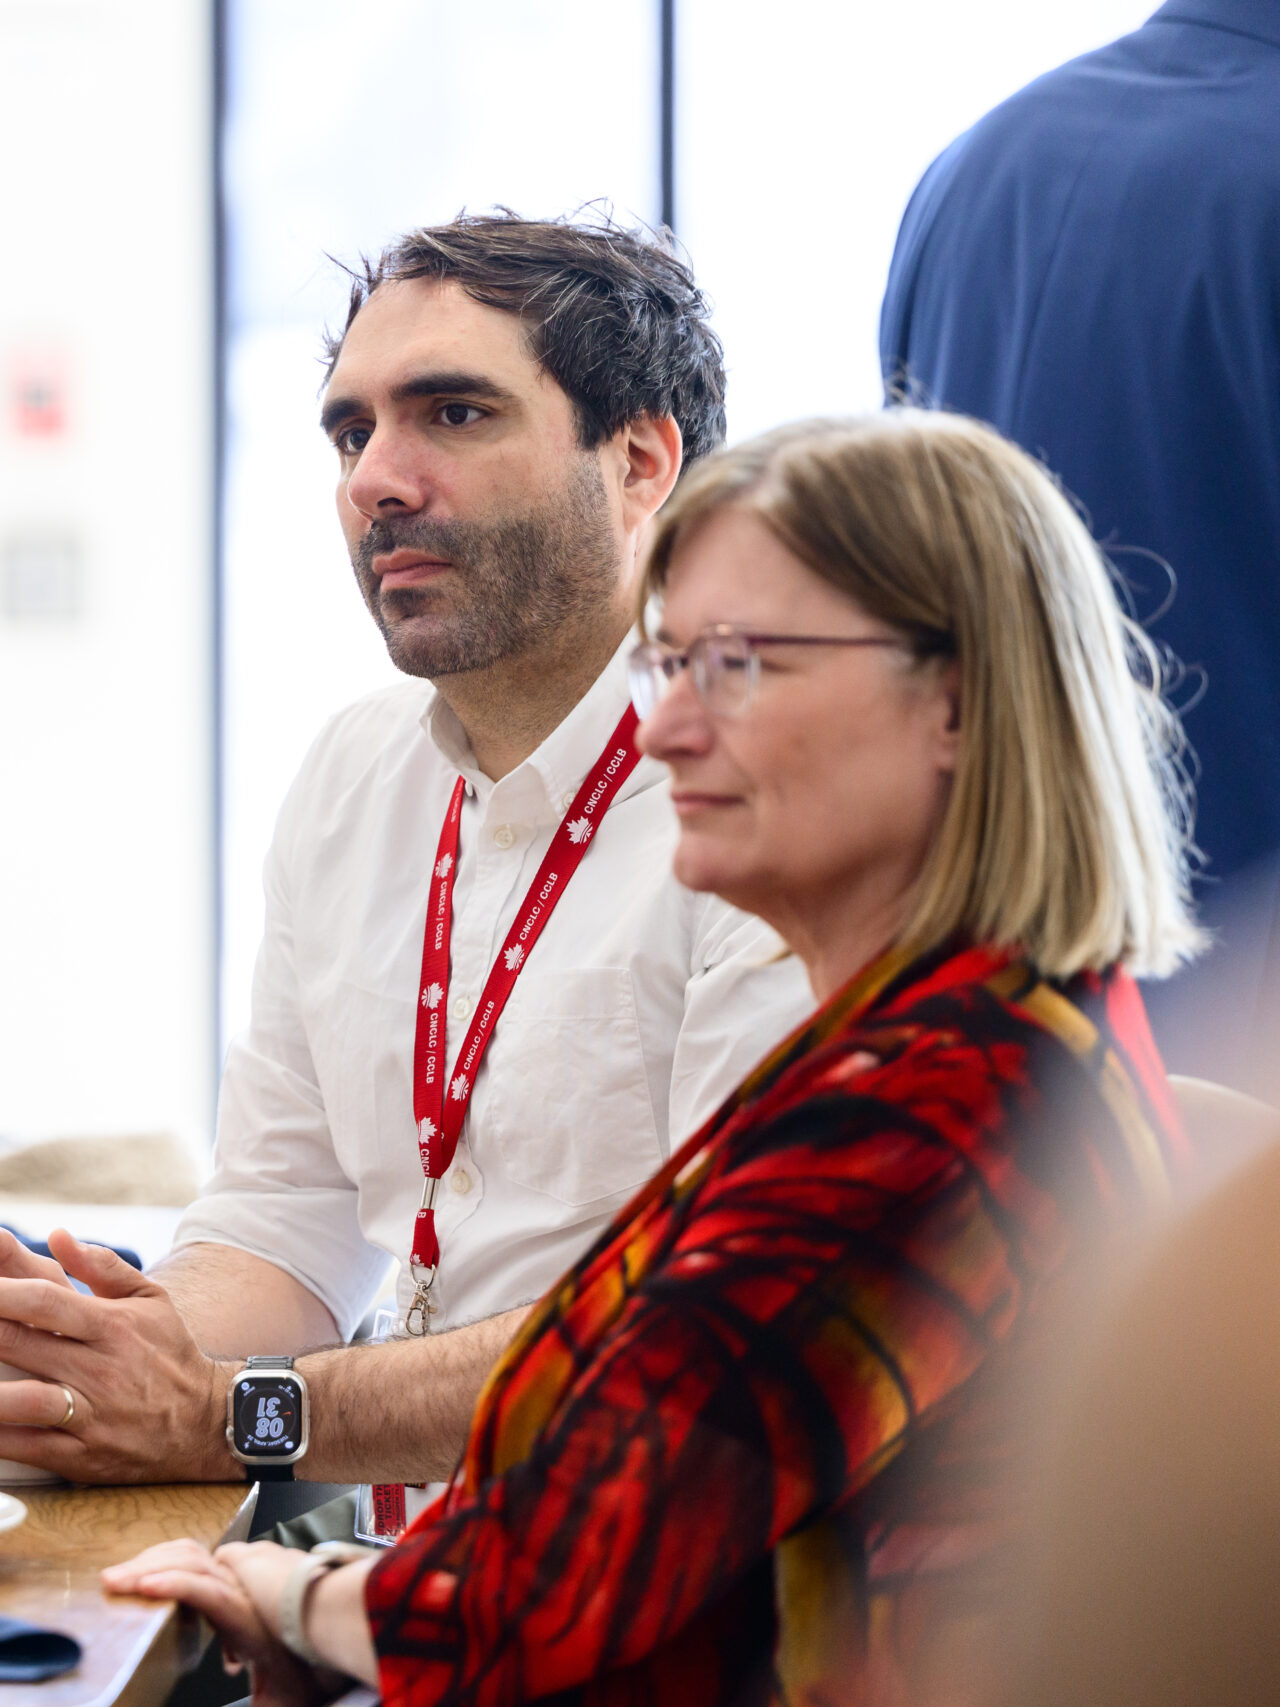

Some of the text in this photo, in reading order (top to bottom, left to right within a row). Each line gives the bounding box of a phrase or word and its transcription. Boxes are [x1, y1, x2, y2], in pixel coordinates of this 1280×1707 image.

[584, 779, 608, 814] CNCLC
[606, 748, 627, 776] CCLB
[438, 881, 448, 915] CNCLC
[519, 906, 541, 941] CNCLC
[539, 872, 559, 900] CCLB
[435, 922, 445, 950] CCLB
[428, 1012, 439, 1048] CNCLC
[463, 1035, 481, 1071] CNCLC
[480, 1000, 495, 1029] CCLB
[426, 1056, 436, 1084] CCLB
[256, 1397, 281, 1418] 31
[255, 1417, 284, 1438] 08
[376, 1499, 384, 1528] DROP
[383, 1484, 392, 1519] TICKET
